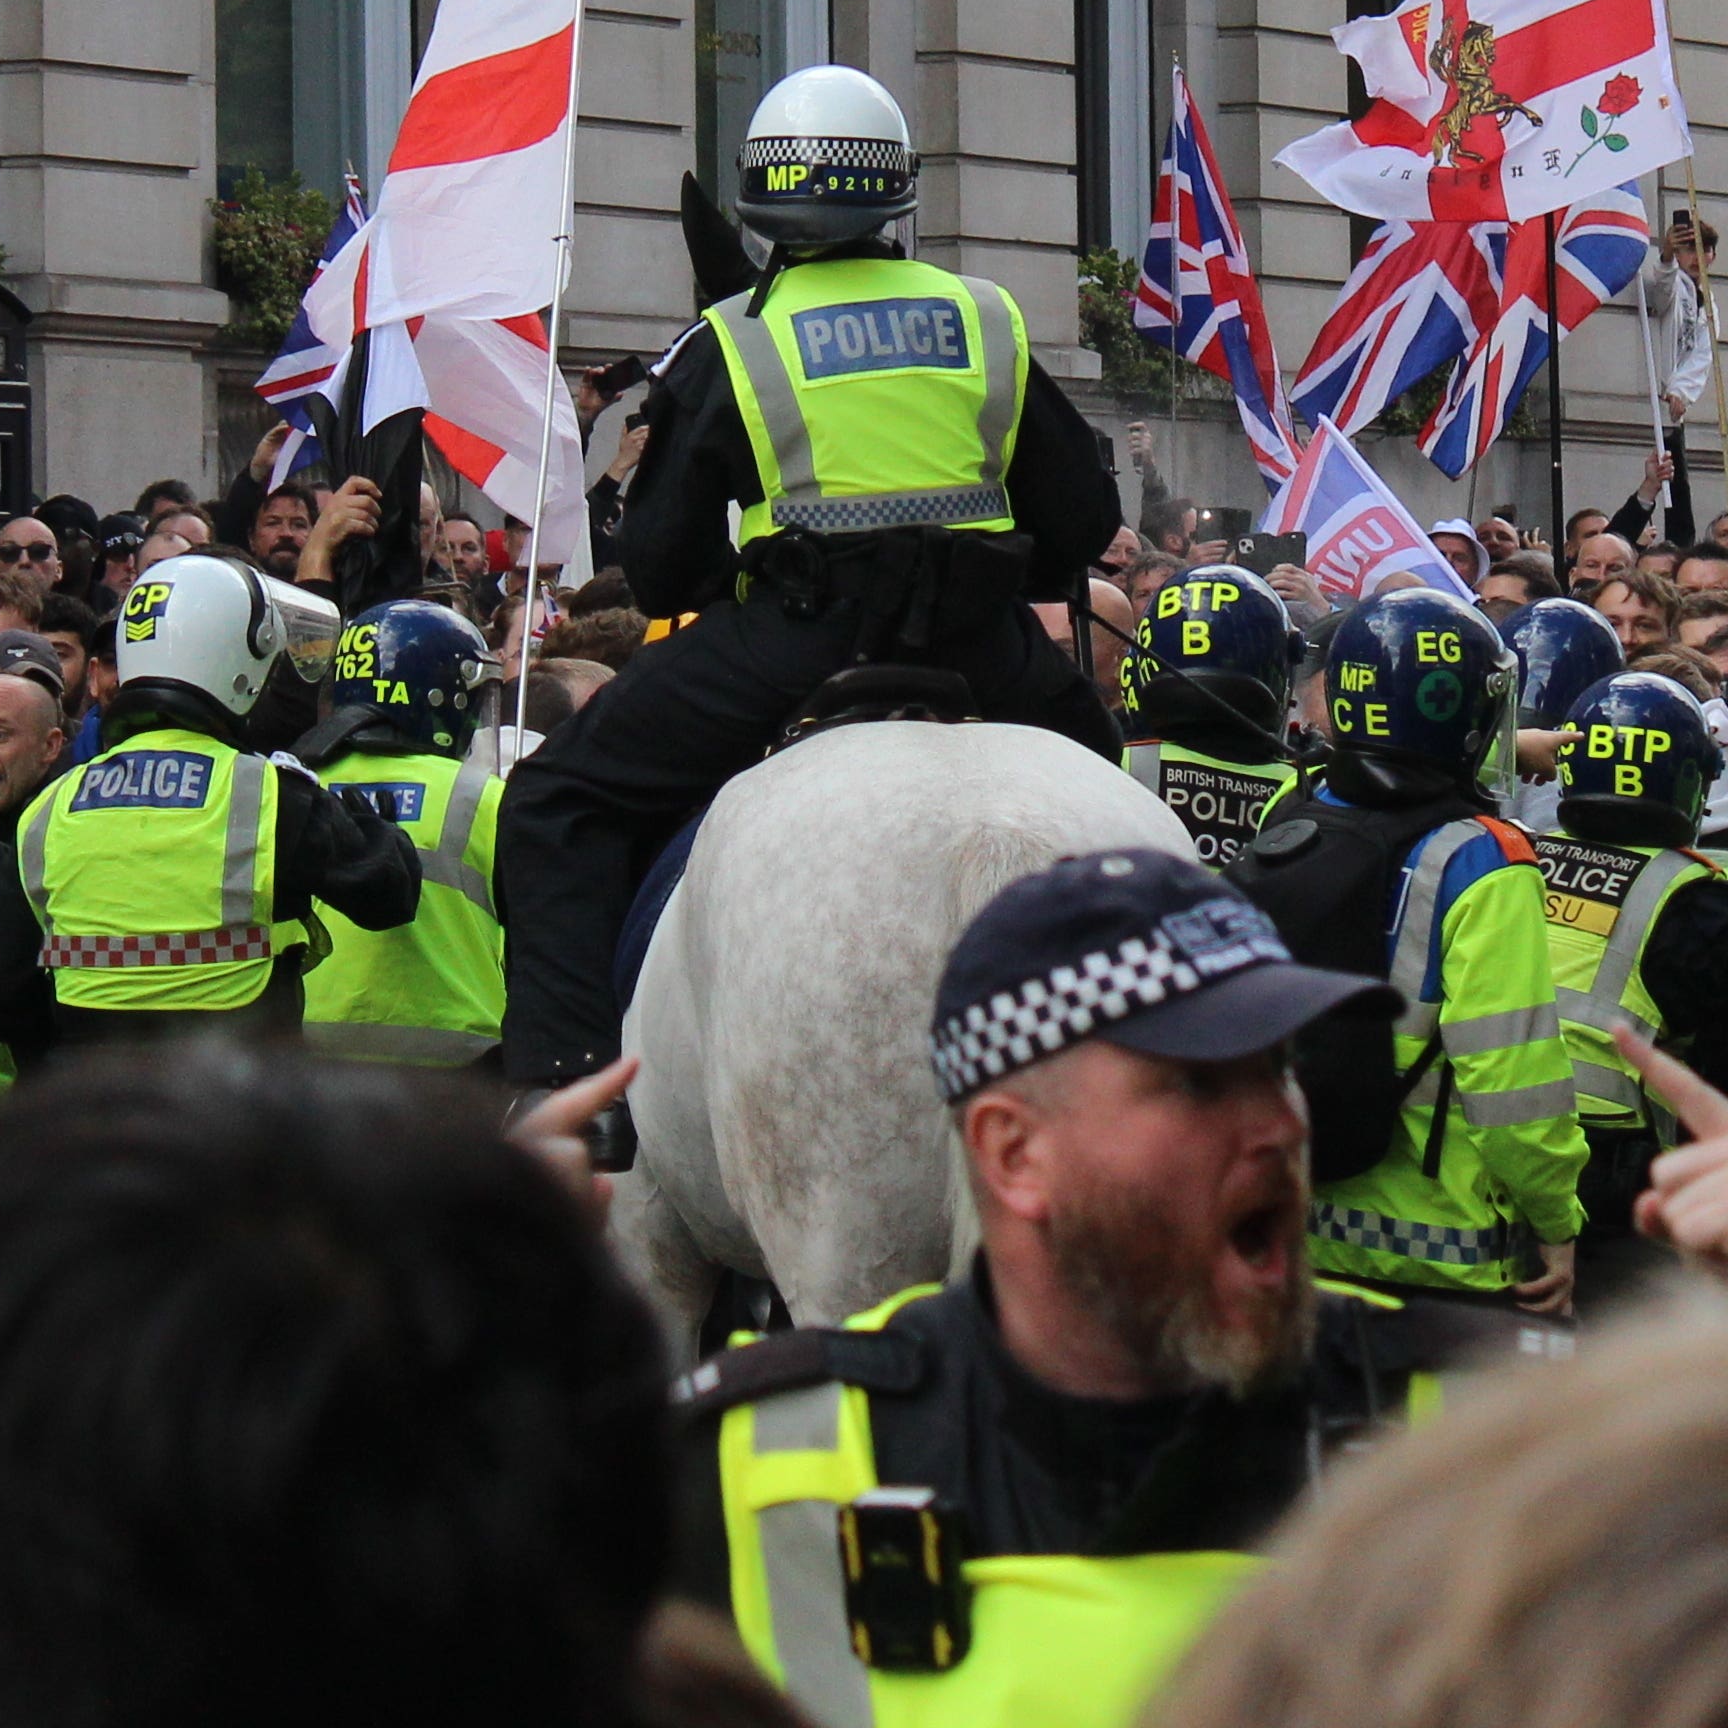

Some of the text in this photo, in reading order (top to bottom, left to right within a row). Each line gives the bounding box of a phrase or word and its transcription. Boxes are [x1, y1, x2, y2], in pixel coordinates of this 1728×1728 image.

[767, 164, 885, 192] MP 9218
[803, 308, 959, 364] POLICE
[126, 584, 170, 617] CP
[1158, 581, 1240, 619] BTP
[336, 624, 379, 655] NC
[1182, 621, 1211, 655] B
[1416, 631, 1462, 663] EG
[335, 653, 374, 682] 762
[1340, 665, 1375, 693] MP
[373, 679, 410, 705] TA
[1587, 724, 1672, 763] BTP
[78, 759, 205, 803] POLICE
[1166, 768, 1277, 798] BRITISH TRANSPO
[1614, 764, 1644, 797] B
[1166, 787, 1264, 832] POLIC
[1566, 845, 1641, 872] TRANSPORT
[1537, 857, 1629, 897] OLICE
[1544, 894, 1585, 923] SU
